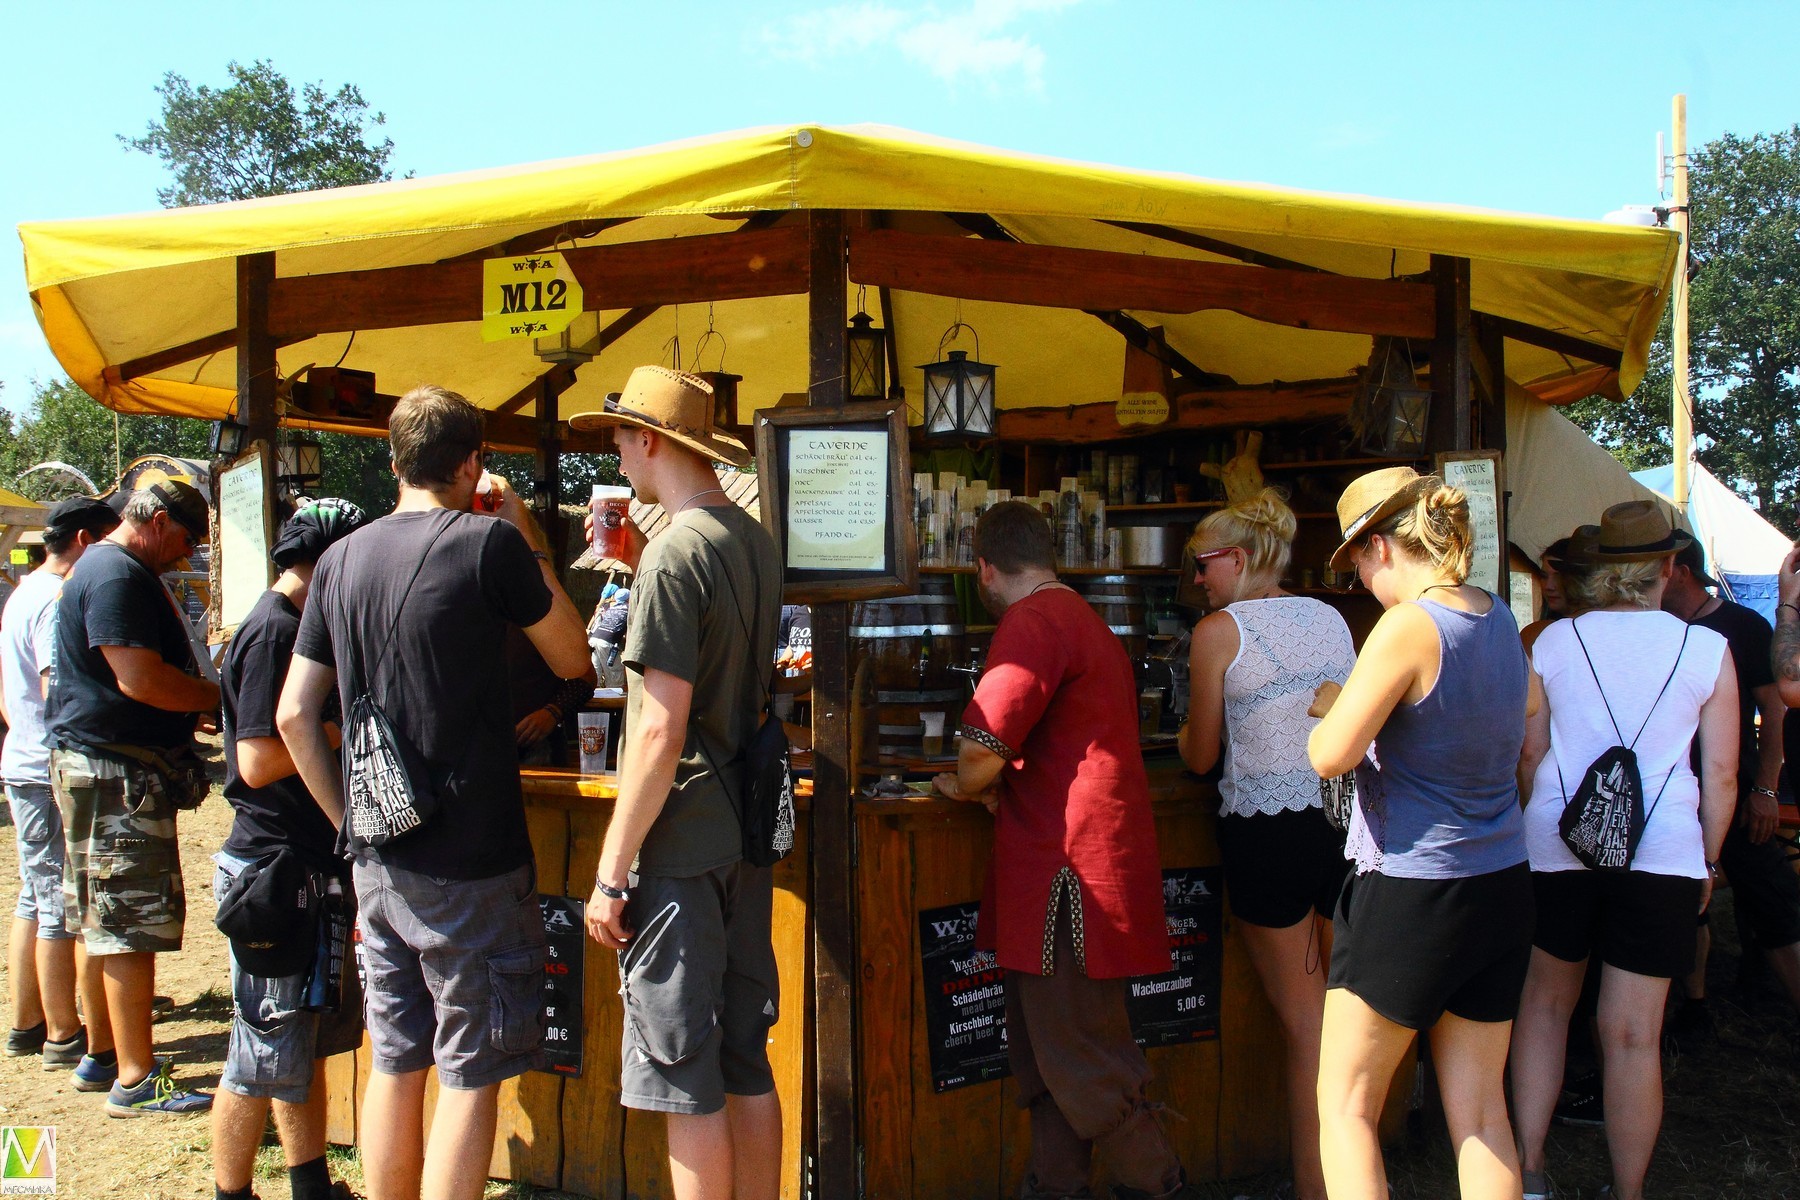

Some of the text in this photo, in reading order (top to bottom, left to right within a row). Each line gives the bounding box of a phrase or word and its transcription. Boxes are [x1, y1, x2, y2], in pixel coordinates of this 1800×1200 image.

[500, 279, 567, 314] M12
[809, 441, 868, 451] TAVERNE
[1454, 463, 1486, 475] TAVERNE
[356, 793, 371, 809] 29
[387, 806, 422, 837] 2018
[1599, 849, 1628, 867] 2018
[1171, 949, 1179, 960] et
[952, 984, 1003, 1007] Schädelbräu
[1132, 976, 1193, 997] Wackenzauber
[961, 996, 1006, 1017] mead beer
[949, 1014, 994, 1035] Kirschbier
[944, 1026, 995, 1048] cherry beer
